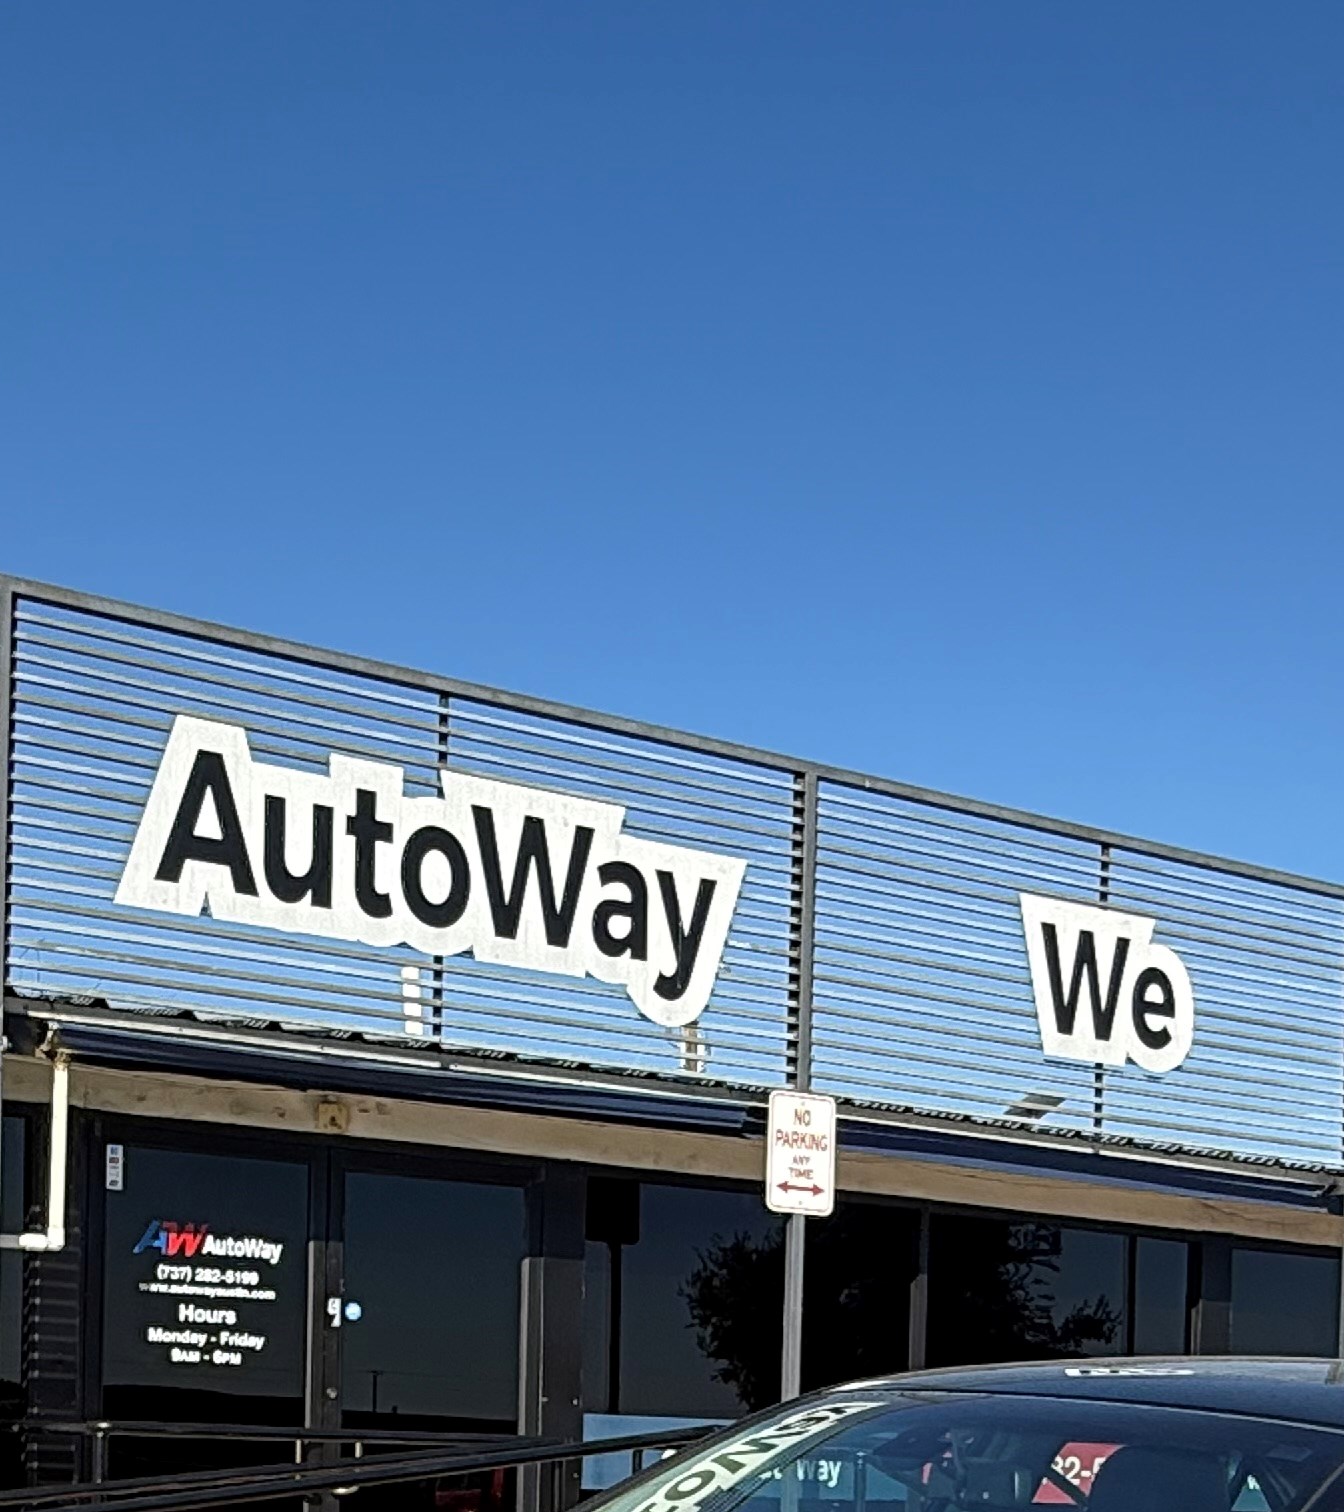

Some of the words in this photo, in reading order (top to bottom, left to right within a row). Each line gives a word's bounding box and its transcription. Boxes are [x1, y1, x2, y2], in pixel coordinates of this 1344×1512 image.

[155, 750, 717, 1000] AutoWay
[1039, 921, 1177, 1050] We
[793, 1108, 811, 1126] NO
[775, 1129, 828, 1152] PARKING
[792, 1155, 811, 1166] ANY
[788, 1166, 814, 1180] TIME
[133, 1219, 208, 1258] AW
[201, 1234, 284, 1265] AutoWay
[156, 1264, 192, 1282] (737)
[178, 1303, 237, 1326] Hours
[147, 1327, 208, 1347] Monday
[219, 1331, 266, 1351] Friday
